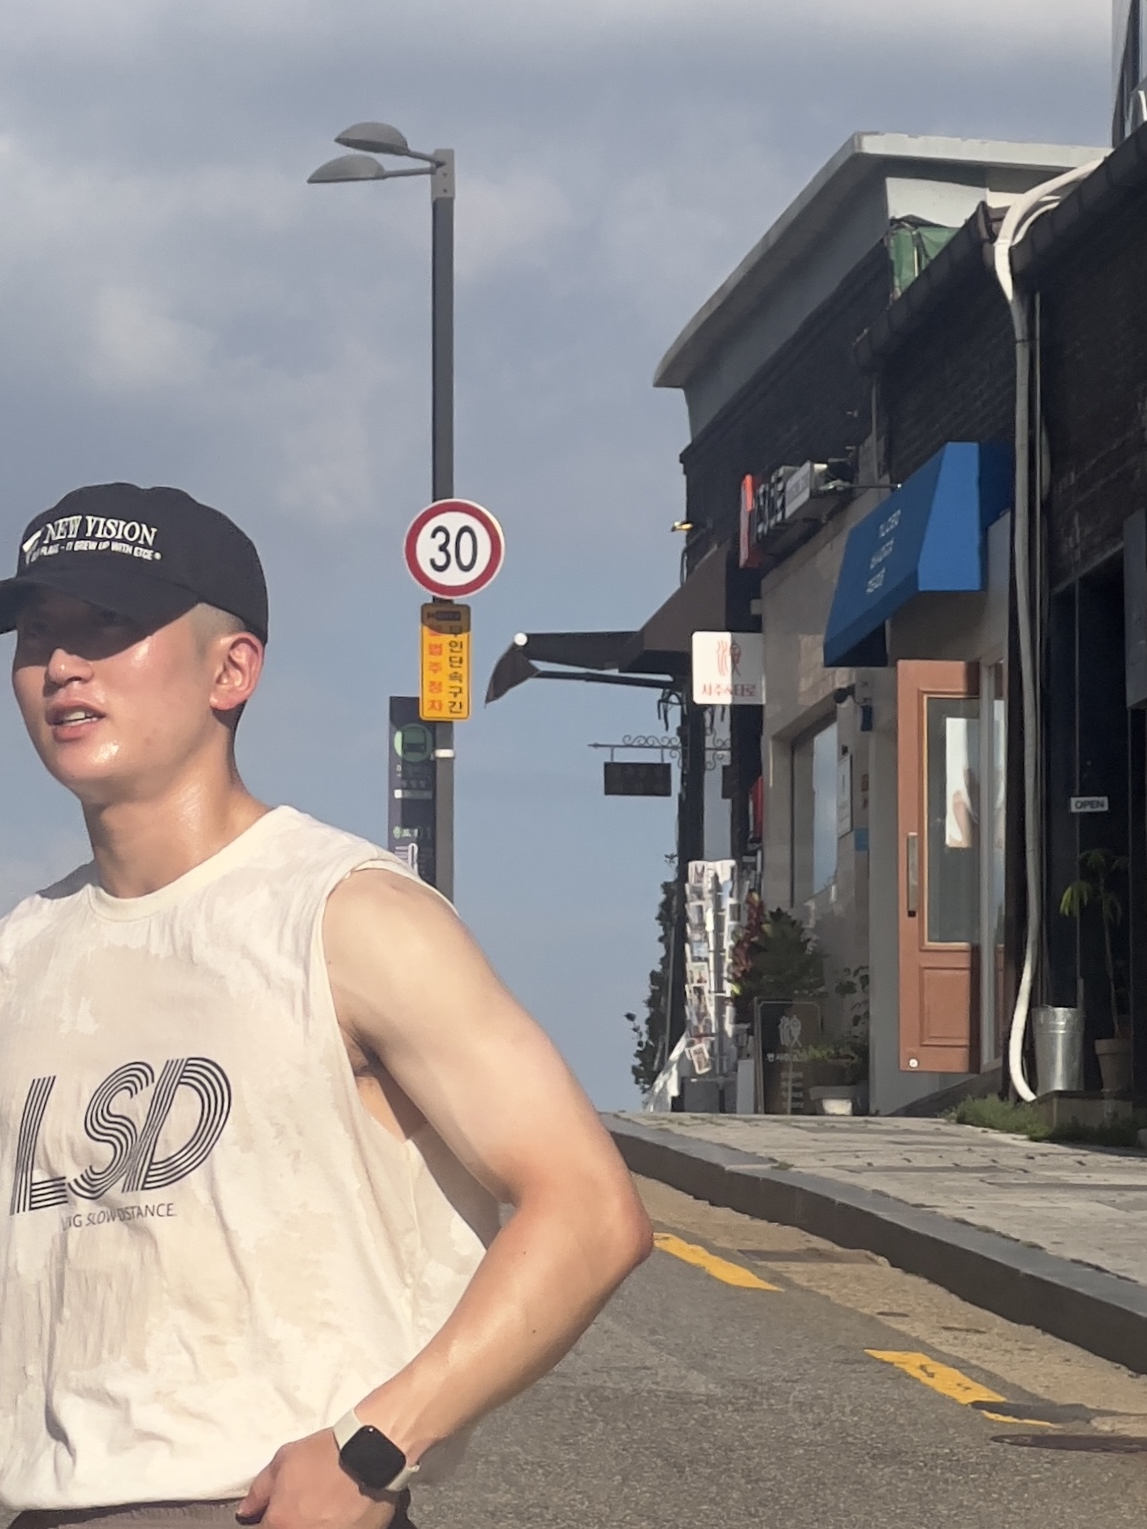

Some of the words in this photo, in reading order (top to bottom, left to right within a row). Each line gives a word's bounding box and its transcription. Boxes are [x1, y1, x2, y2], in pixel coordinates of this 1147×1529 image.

[43, 515, 82, 544] NEW
[85, 515, 157, 546] VISION
[430, 525, 478, 573] 30
[1075, 800, 1104, 809] OPEN
[9, 1057, 232, 1216] LSD
[86, 1209, 116, 1226] SLOW
